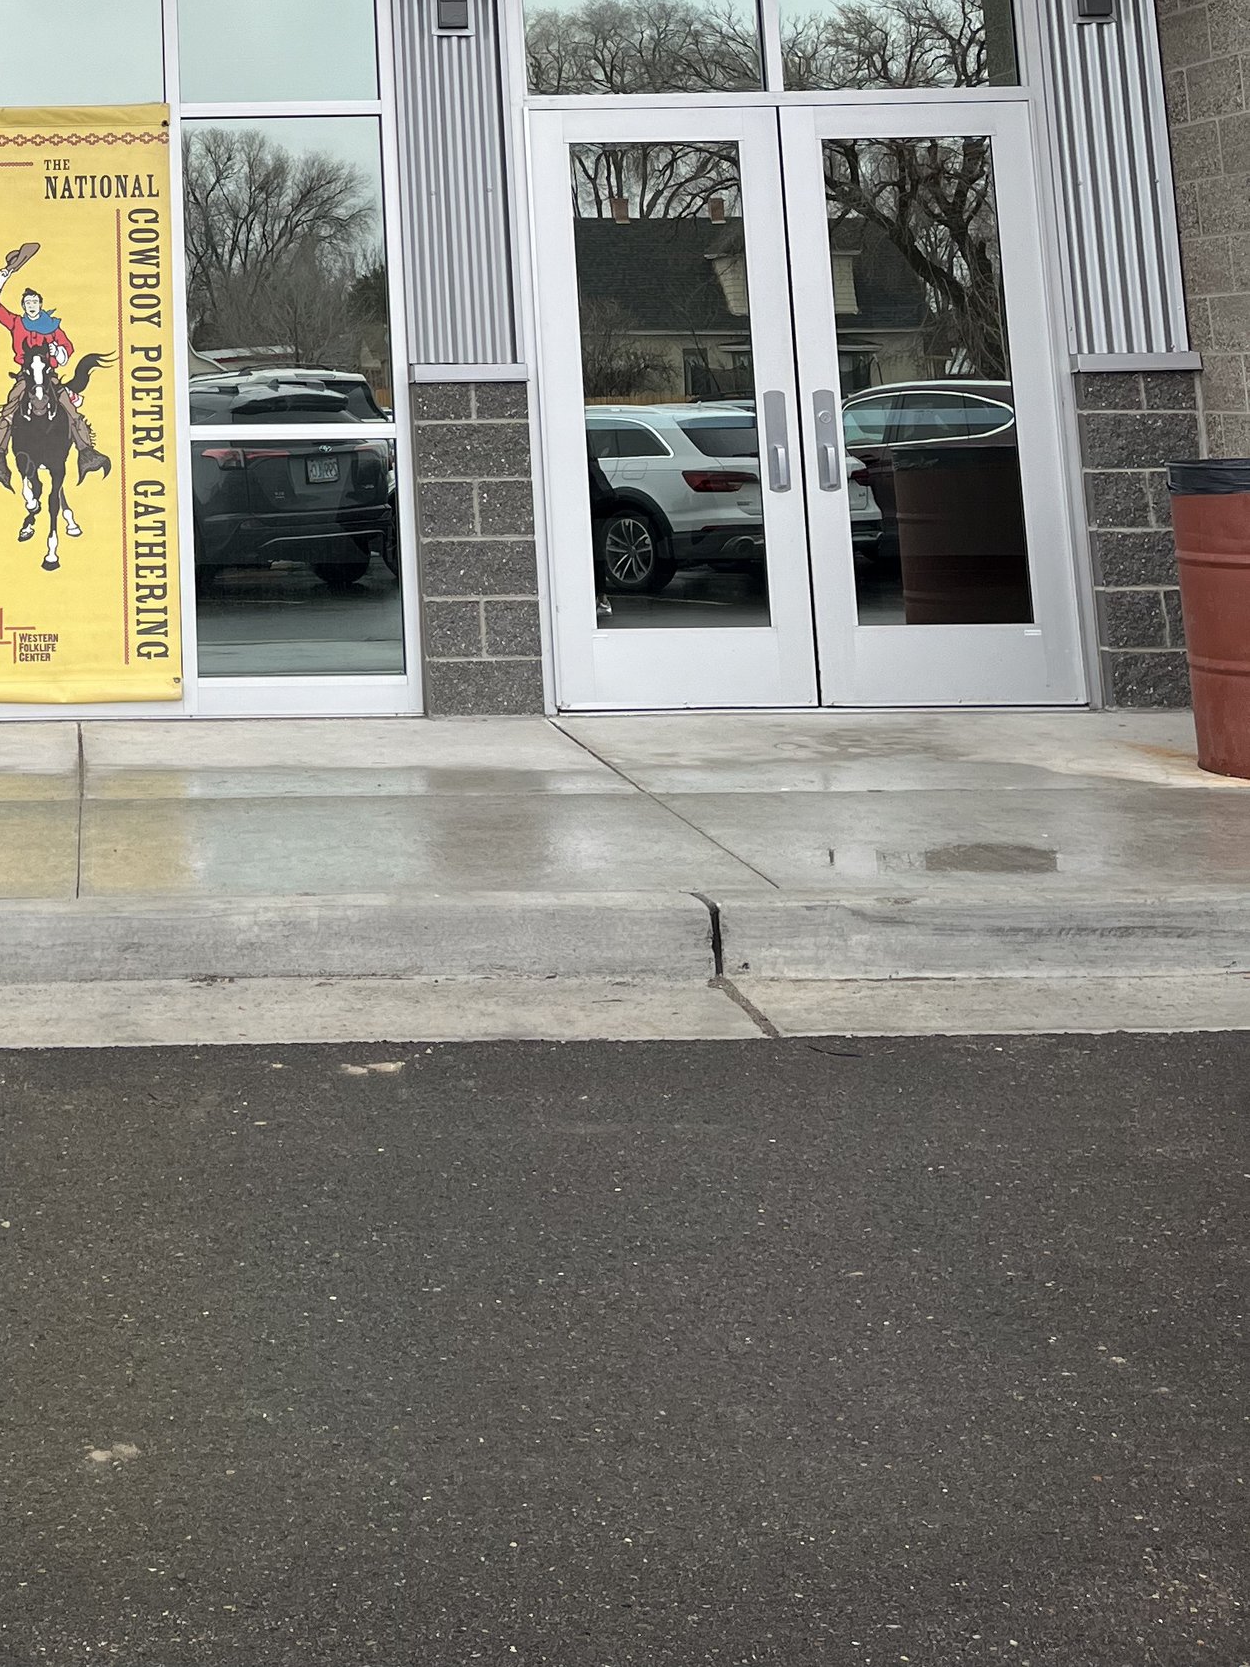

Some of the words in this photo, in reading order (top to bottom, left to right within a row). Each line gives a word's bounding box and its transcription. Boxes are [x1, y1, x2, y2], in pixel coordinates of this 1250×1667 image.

[43, 159, 70, 171] THE
[44, 174, 160, 200] NATIONAL
[127, 208, 161, 329] COWBOY
[130, 344, 165, 463] POETRY
[133, 480, 170, 660] GATHERING
[19, 633, 58, 643] WESTERN
[19, 643, 56, 652] FOLKLIFE
[19, 653, 51, 662] CENTER
